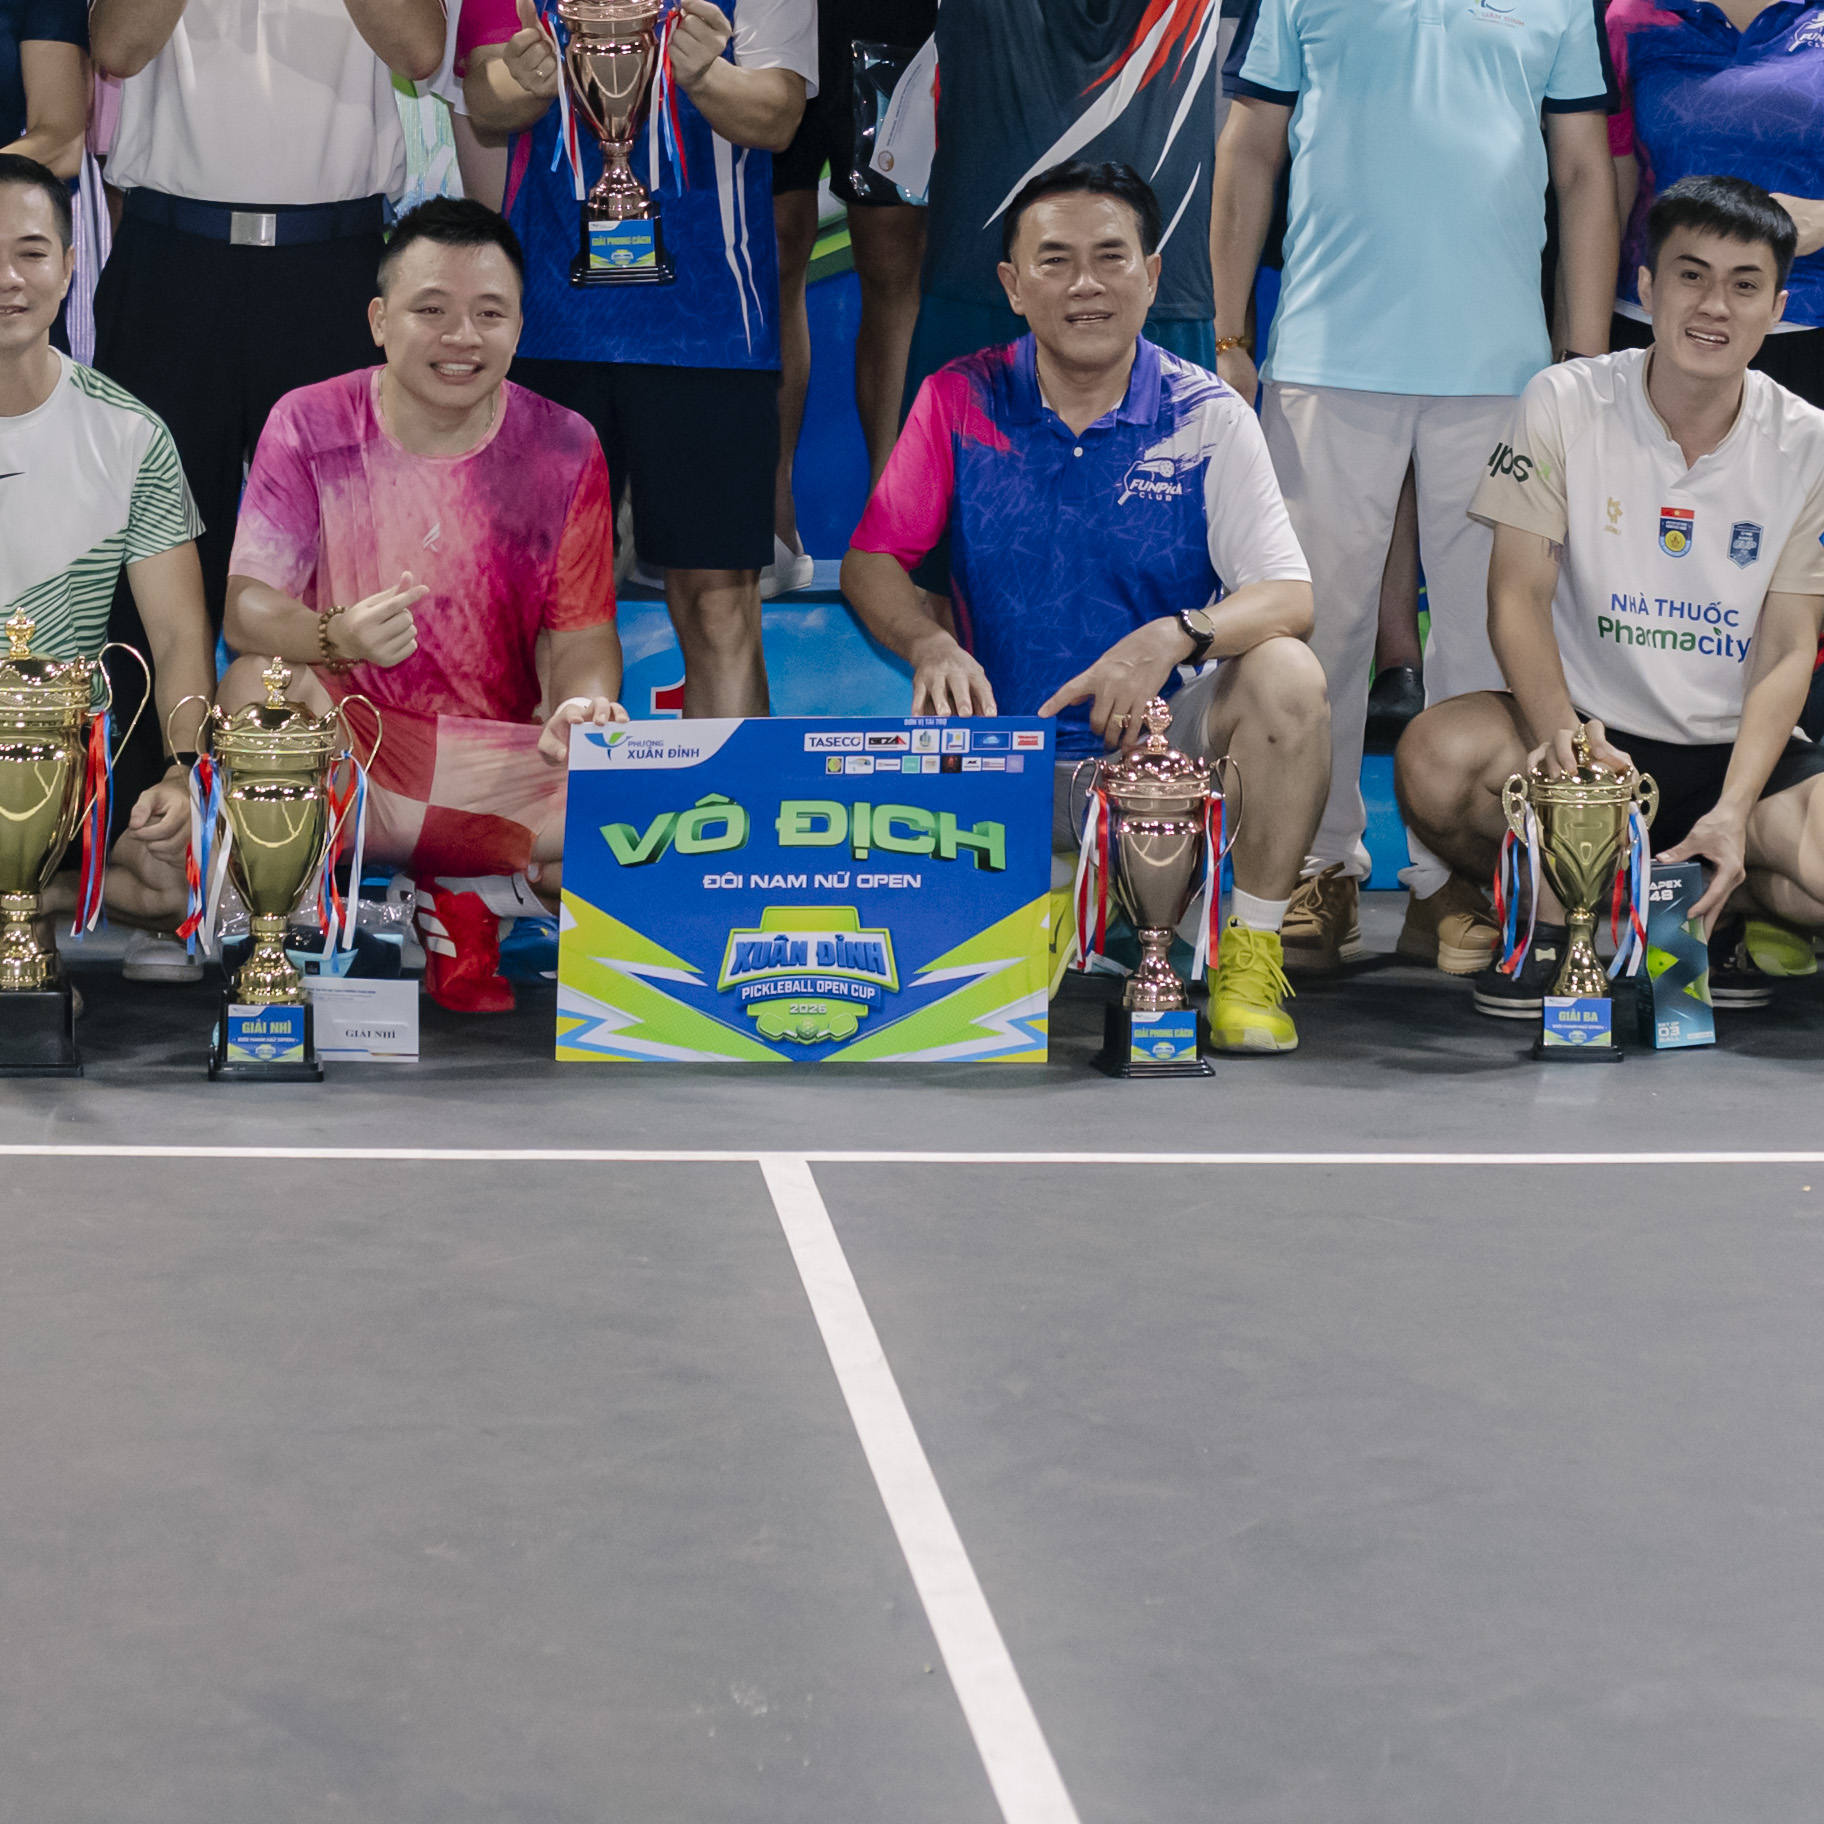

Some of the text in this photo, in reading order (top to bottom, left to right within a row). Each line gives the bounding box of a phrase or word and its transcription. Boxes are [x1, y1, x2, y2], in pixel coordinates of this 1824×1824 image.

[1138, 492, 1173, 502] CLUB
[1610, 590, 1741, 628] NHÀ THUỐC
[1597, 614, 1753, 664] Pharmacity
[808, 736, 861, 747] TASECO
[627, 745, 700, 760] XUÂN ĐỈNH
[599, 792, 1007, 872] VÔ ĐỊCH
[702, 870, 921, 889] ĐÔI NAM NỮ OPEN
[1648, 878, 1684, 890] APEX
[1649, 889, 1674, 902] 48
[729, 933, 887, 976] XUÂN ĐỈNH
[741, 979, 876, 1000] PICKLEBALL OPEN CUP
[788, 1003, 827, 1014] 2026
[1558, 1008, 1599, 1022] GIẢI BA
[242, 1019, 293, 1035] GIẢI NHÌ
[1658, 1026, 1681, 1038] 03
